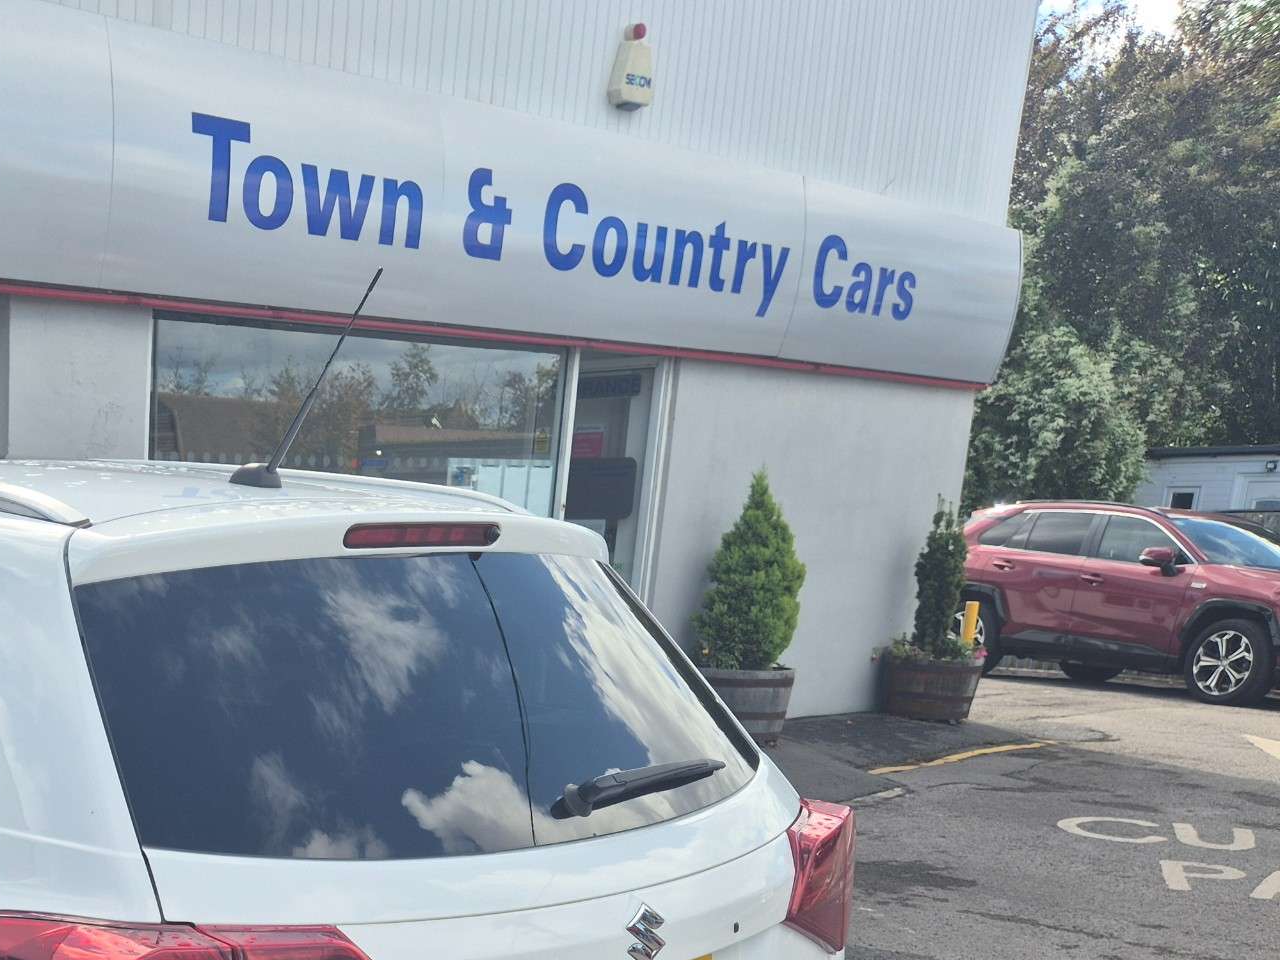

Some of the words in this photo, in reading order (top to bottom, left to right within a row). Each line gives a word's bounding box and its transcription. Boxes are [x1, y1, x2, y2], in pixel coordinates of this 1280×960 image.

[191, 113, 425, 250] Town
[463, 168, 513, 262] &
[541, 183, 791, 318] Country
[811, 233, 918, 321] Cars
[1056, 816, 1258, 851] CU
